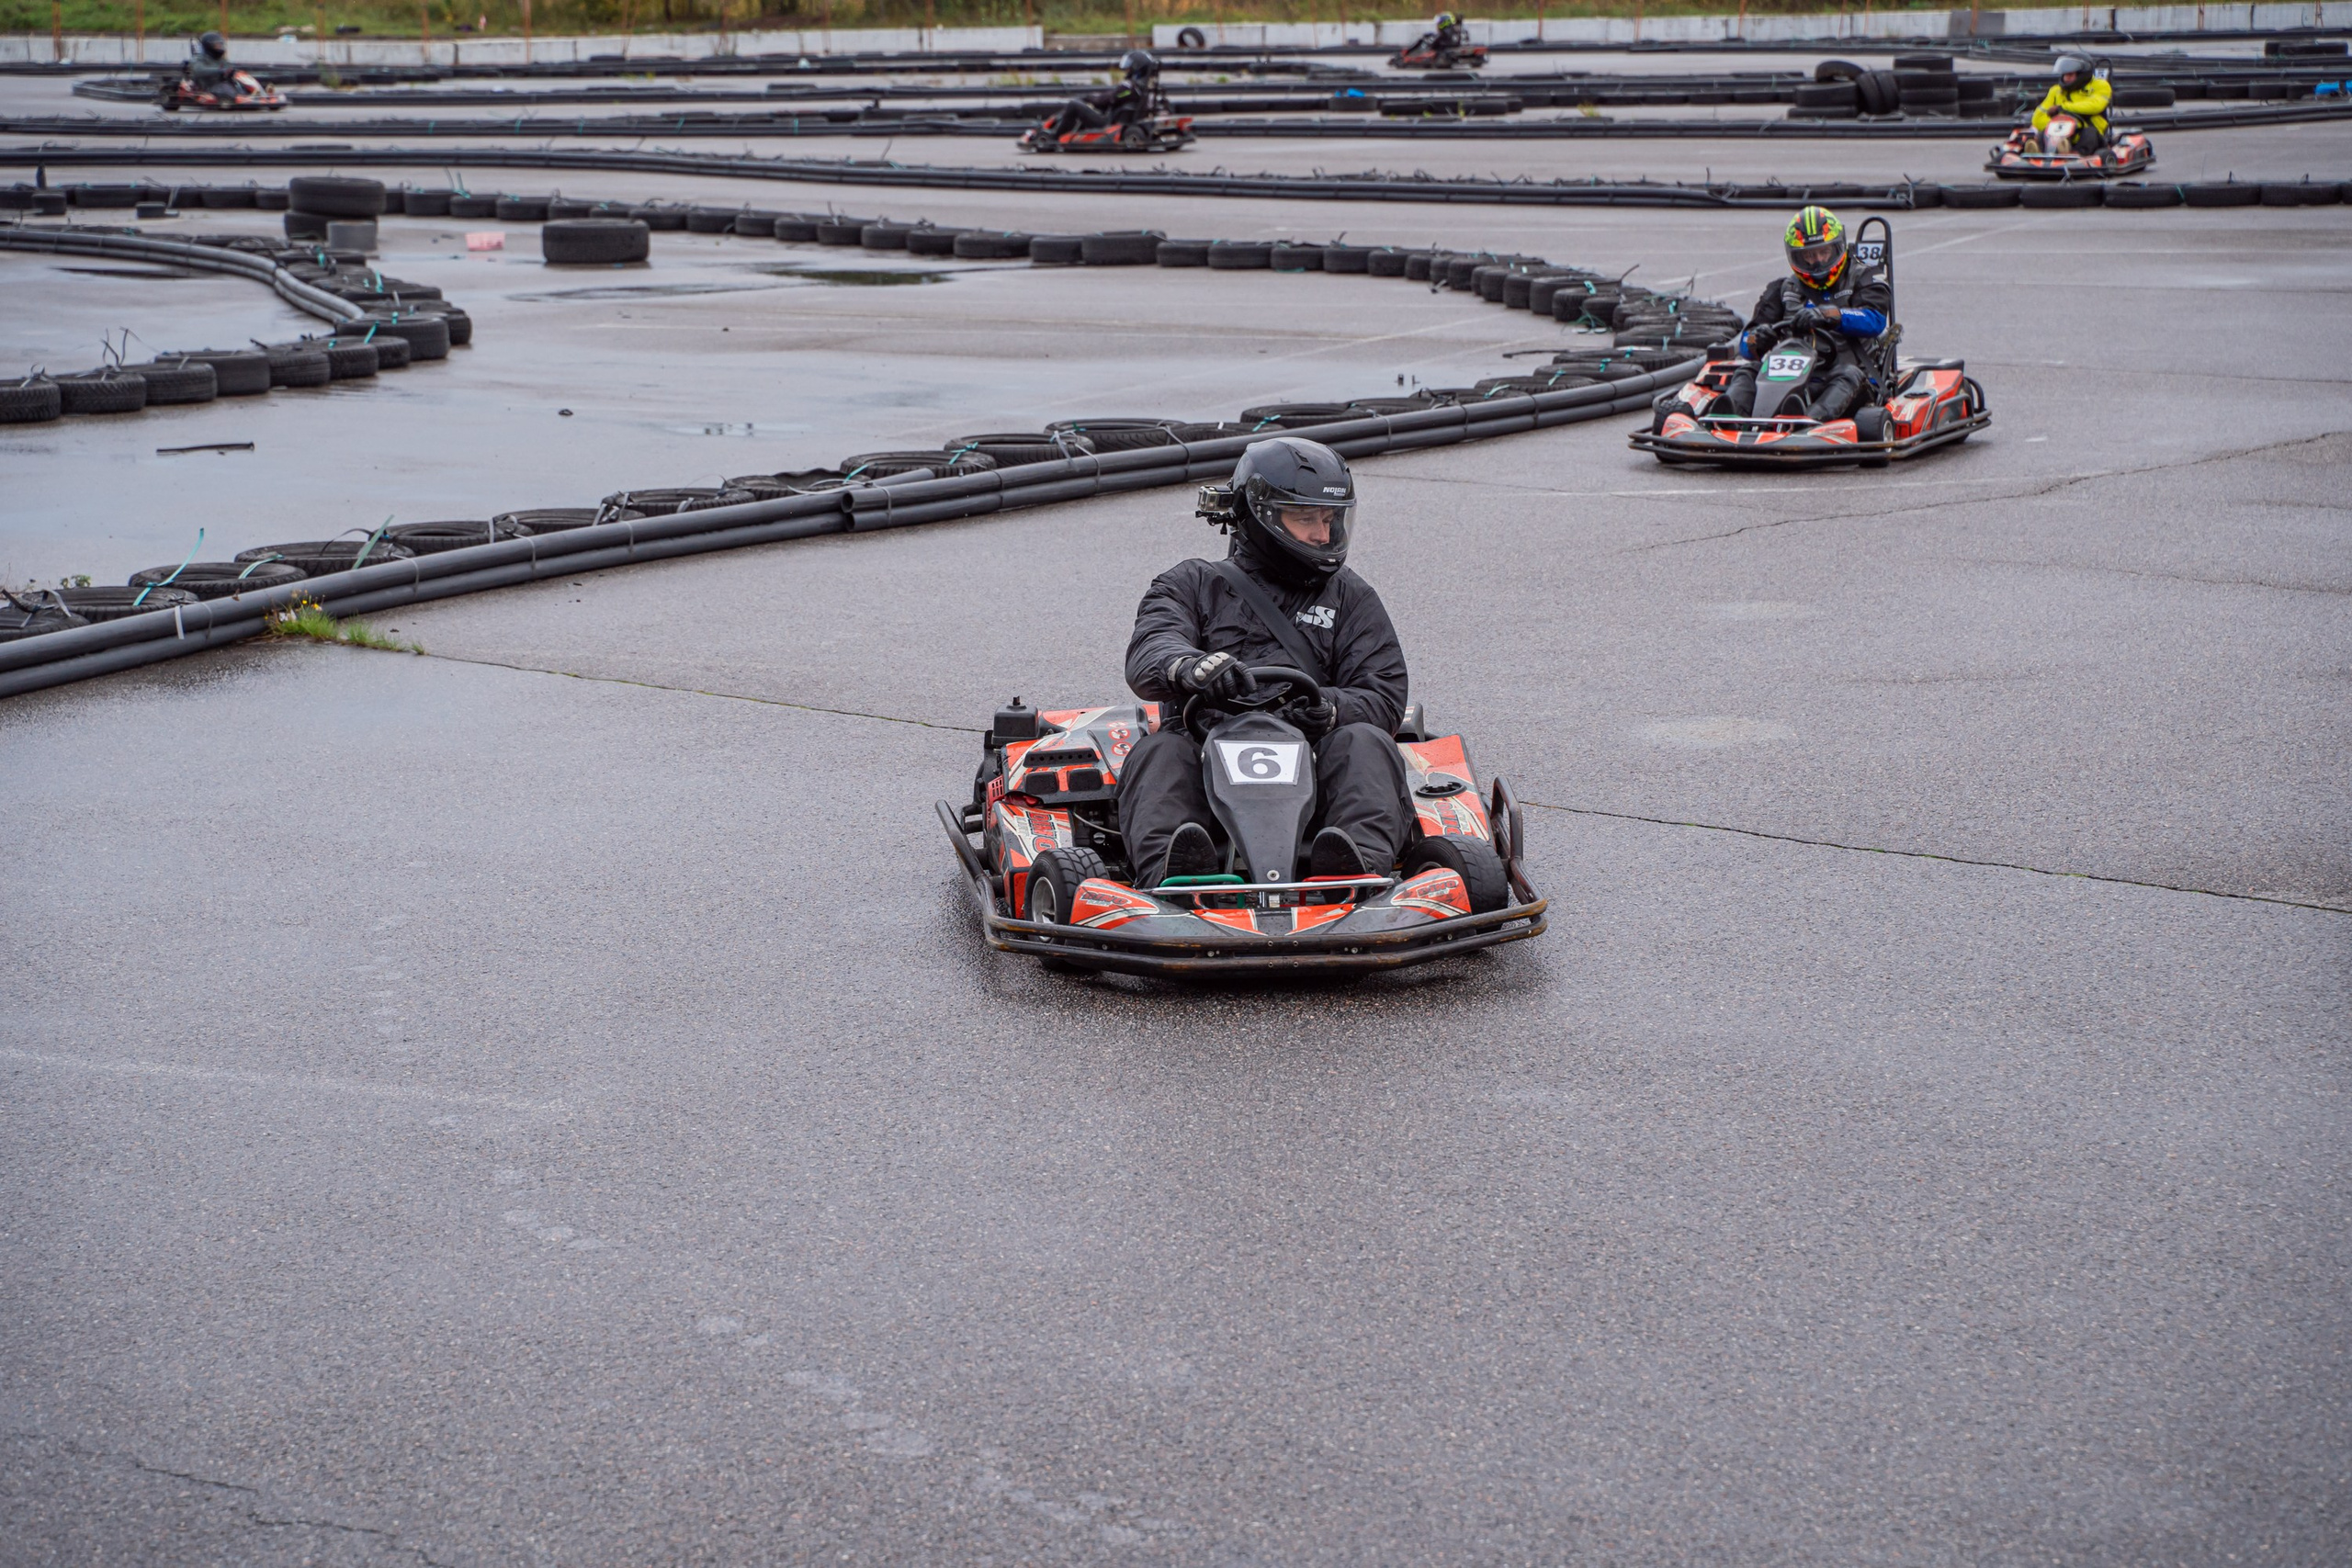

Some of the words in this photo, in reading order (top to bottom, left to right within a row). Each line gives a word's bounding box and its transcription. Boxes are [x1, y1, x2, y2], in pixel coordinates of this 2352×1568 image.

[1859, 246, 1881, 260] 38
[1769, 357, 1804, 370] 38
[1323, 486, 1347, 497] NOLAN
[1238, 746, 1282, 780] 6
[1025, 811, 1059, 853] DINO
[1418, 881, 1457, 897] DINO
[1081, 892, 1130, 906] DINO
